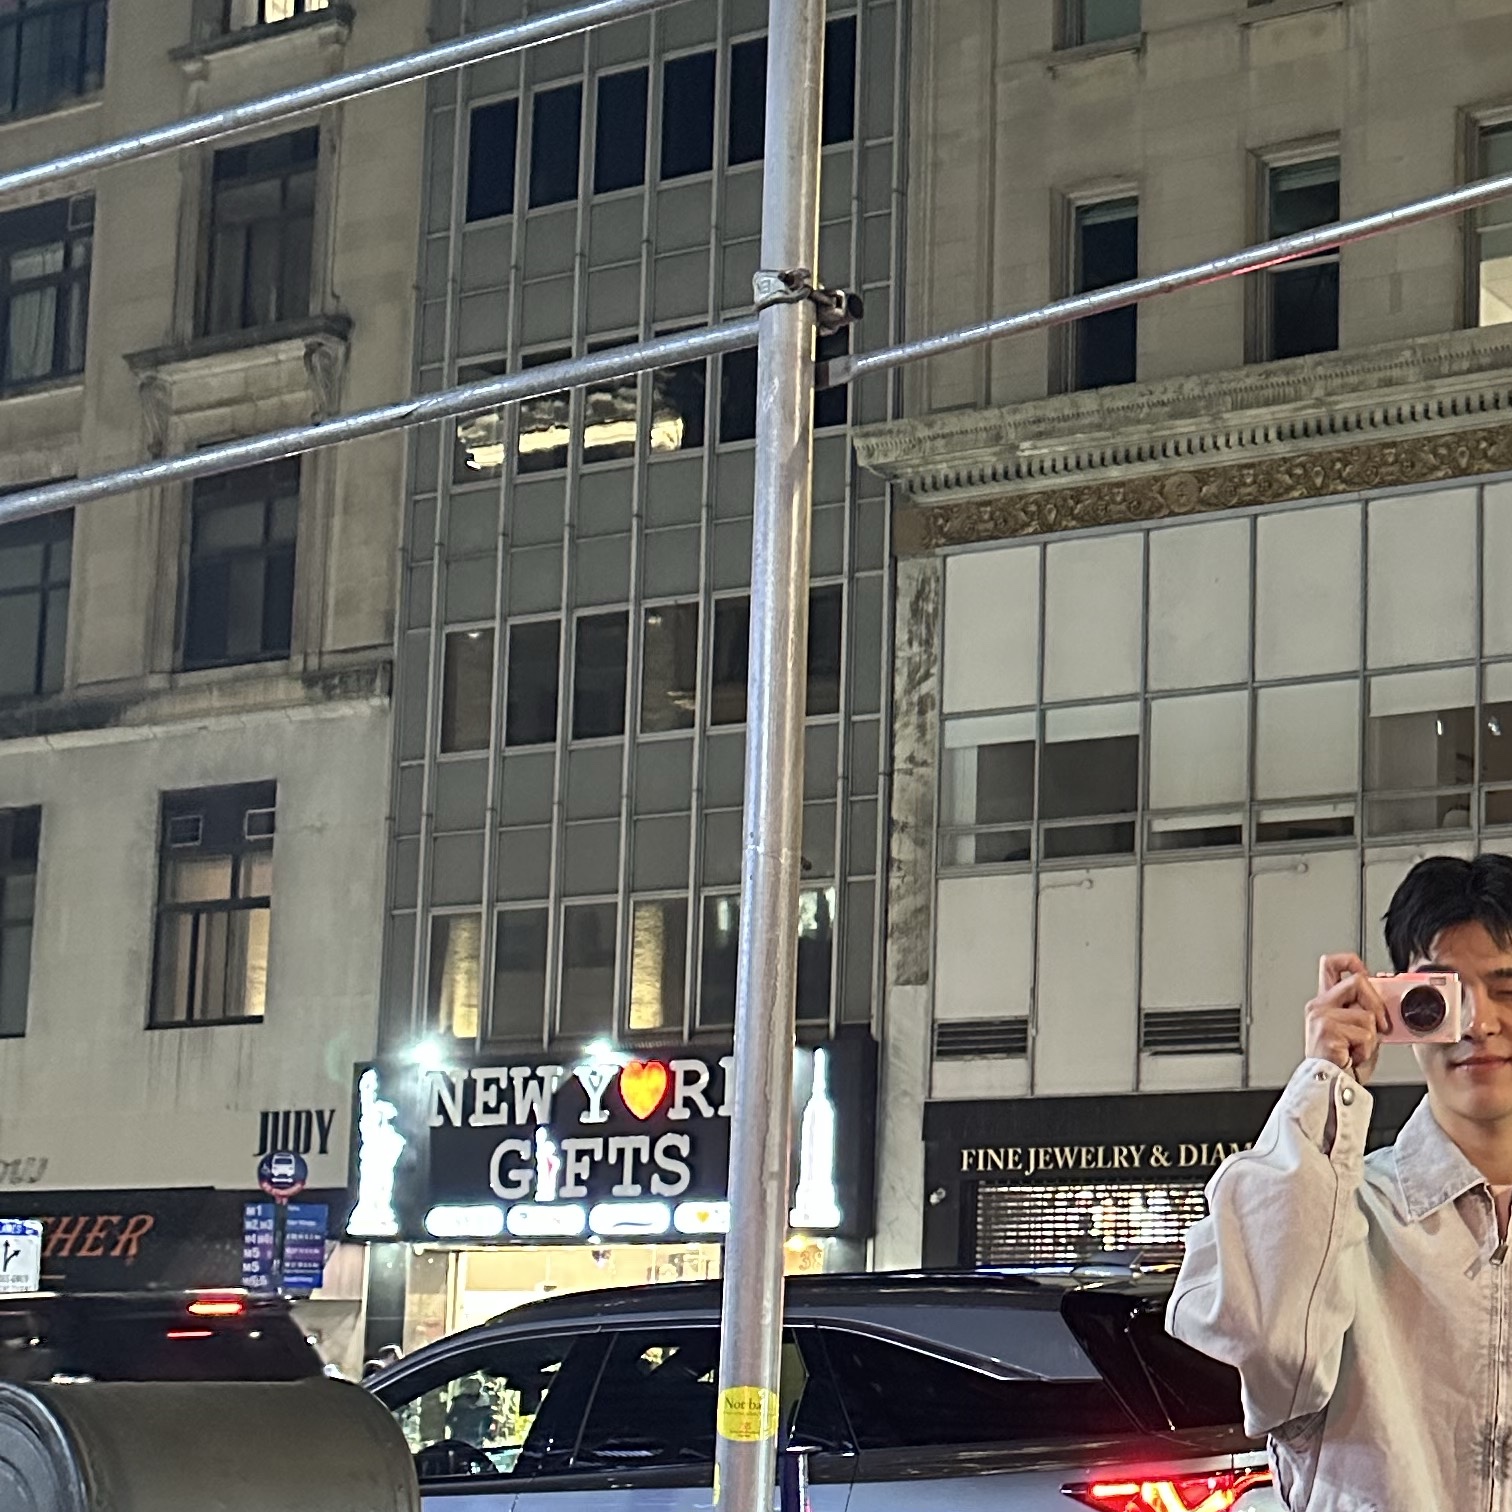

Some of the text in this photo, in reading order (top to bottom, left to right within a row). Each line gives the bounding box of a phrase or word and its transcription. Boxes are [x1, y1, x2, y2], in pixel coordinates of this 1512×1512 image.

[423, 1065, 564, 1128] NEW
[252, 1109, 336, 1157] JUDY
[960, 1148, 1023, 1172] FINE
[1024, 1145, 1146, 1176] JEWELRY
[1150, 1144, 1173, 1168] &
[42, 1214, 155, 1257] HER
